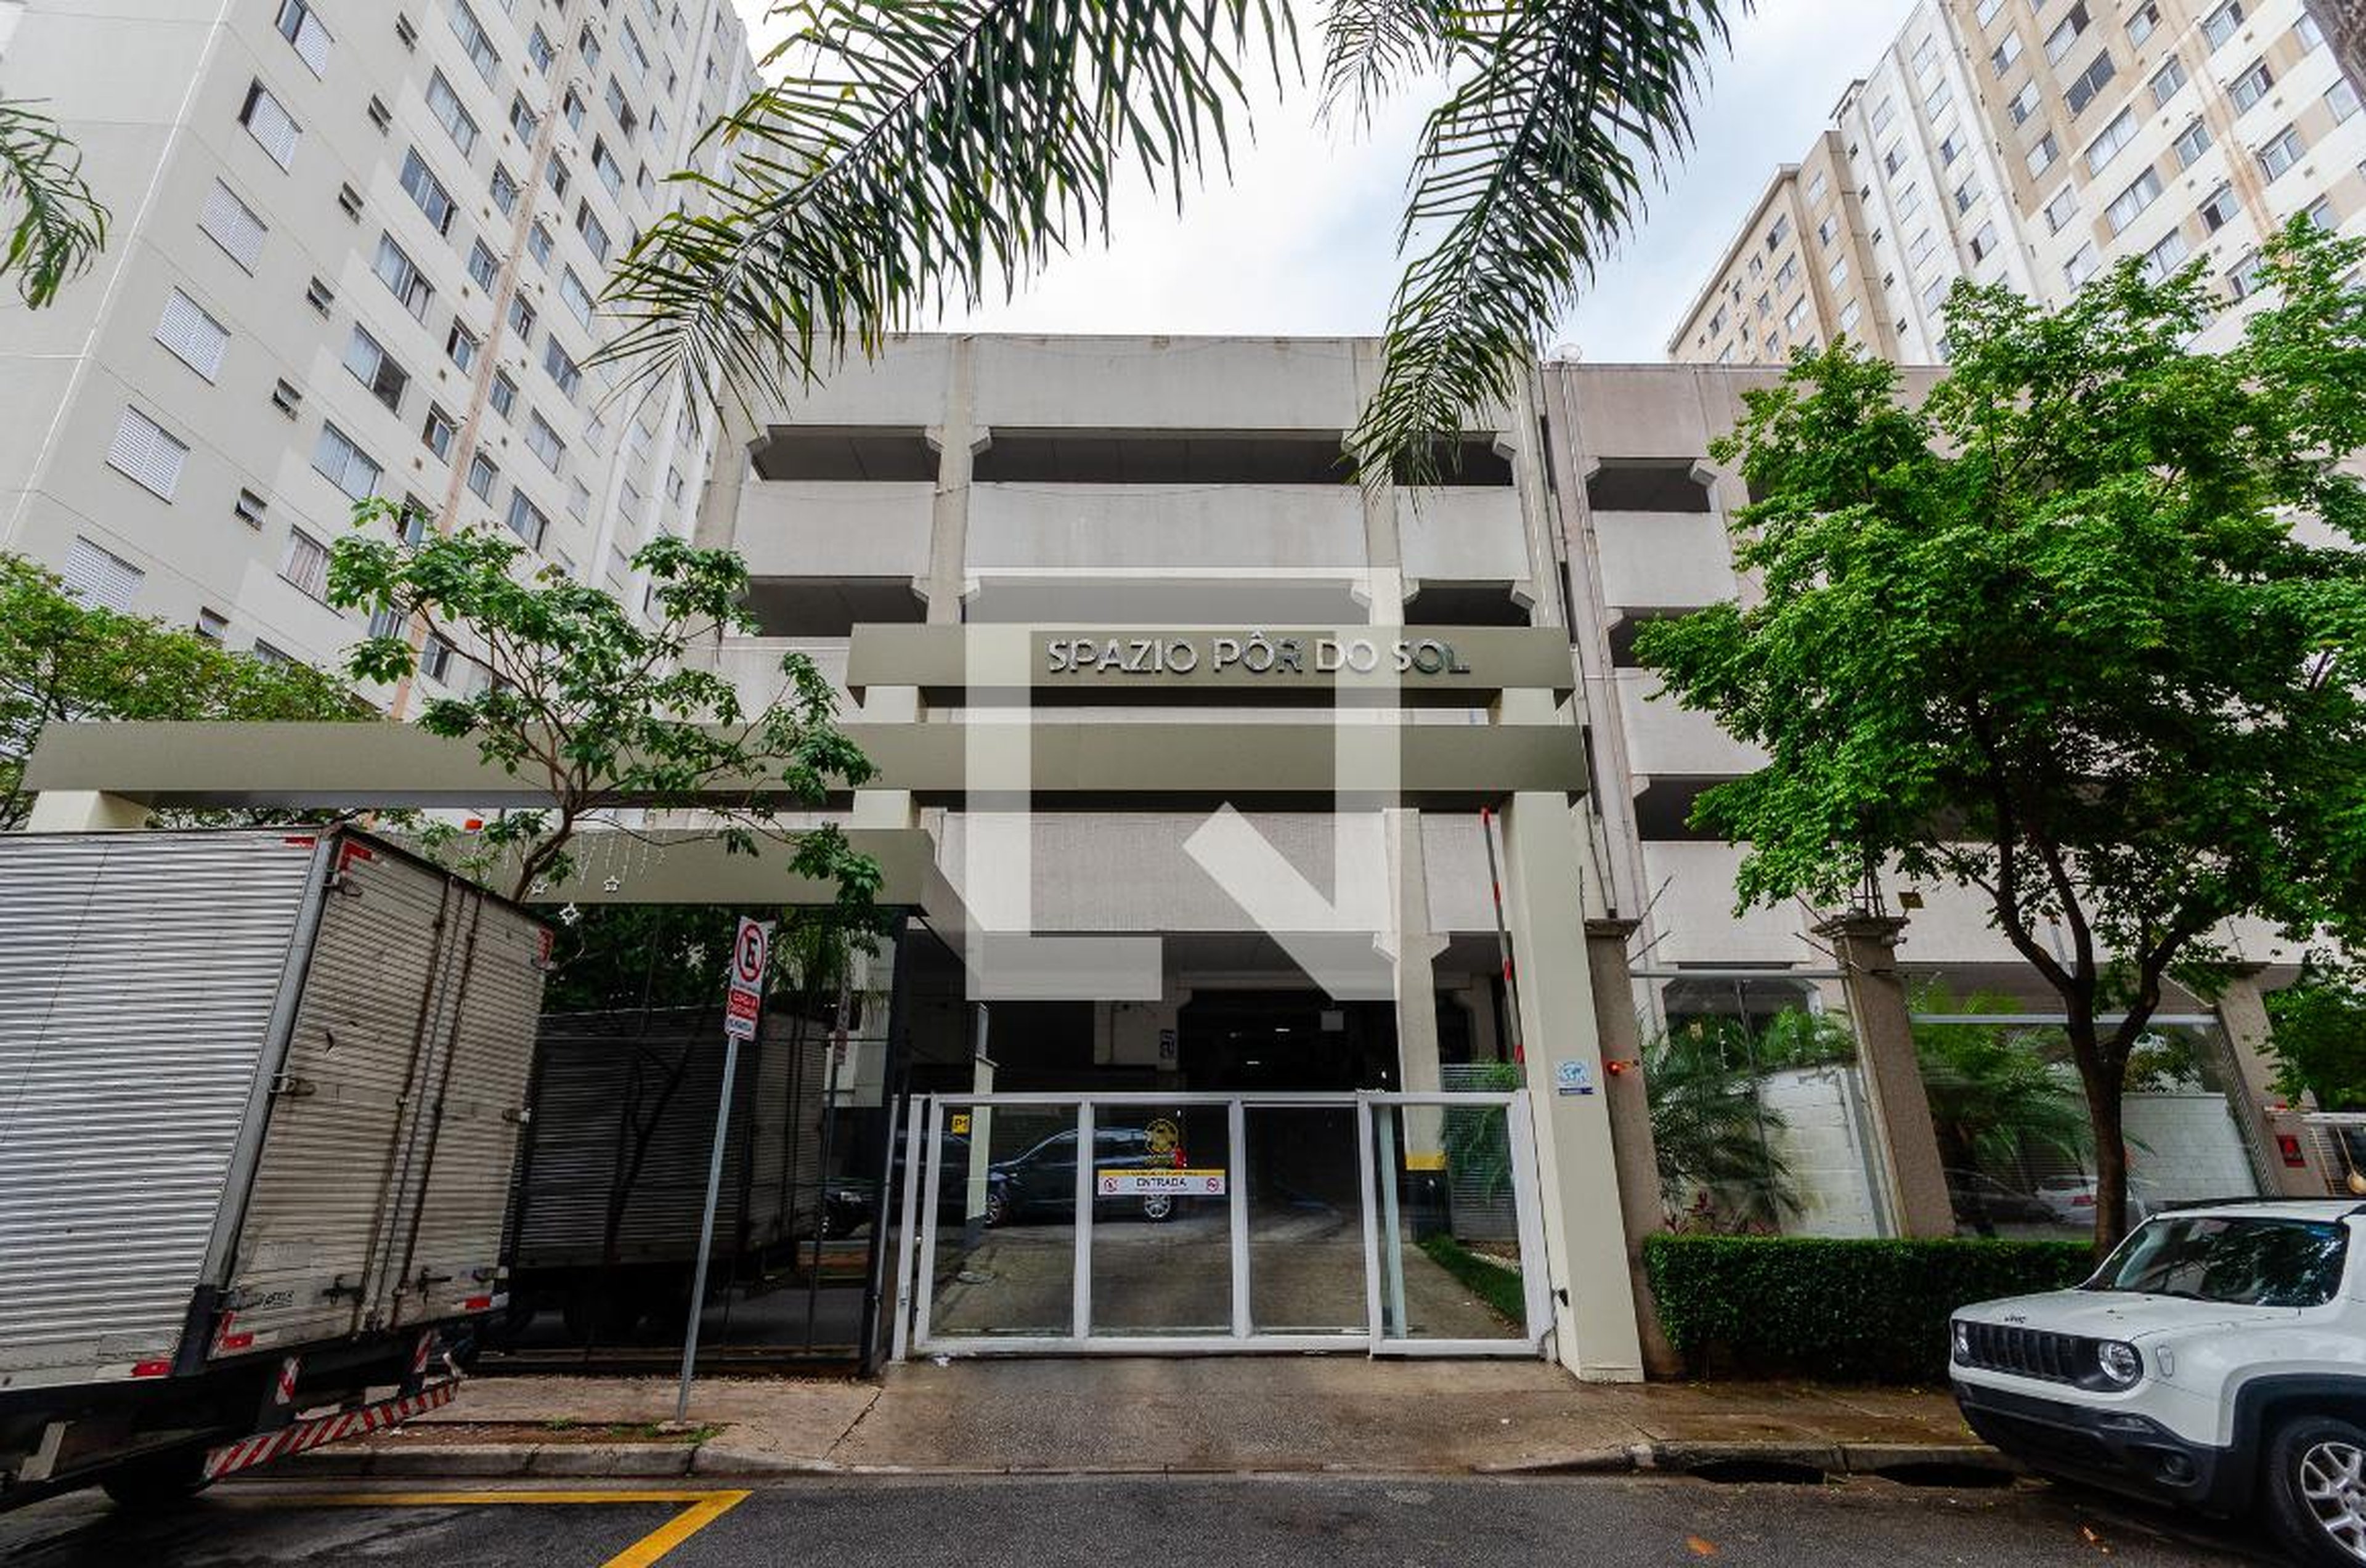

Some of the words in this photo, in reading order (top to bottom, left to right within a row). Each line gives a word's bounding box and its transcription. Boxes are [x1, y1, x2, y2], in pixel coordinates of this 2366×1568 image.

[1047, 638, 1198, 673] SPAZIO
[1213, 630, 1303, 673] PÔR
[1315, 638, 1378, 673] DO
[1391, 638, 1471, 674] SOL
[1136, 1177, 1187, 1187] ENTRADA
